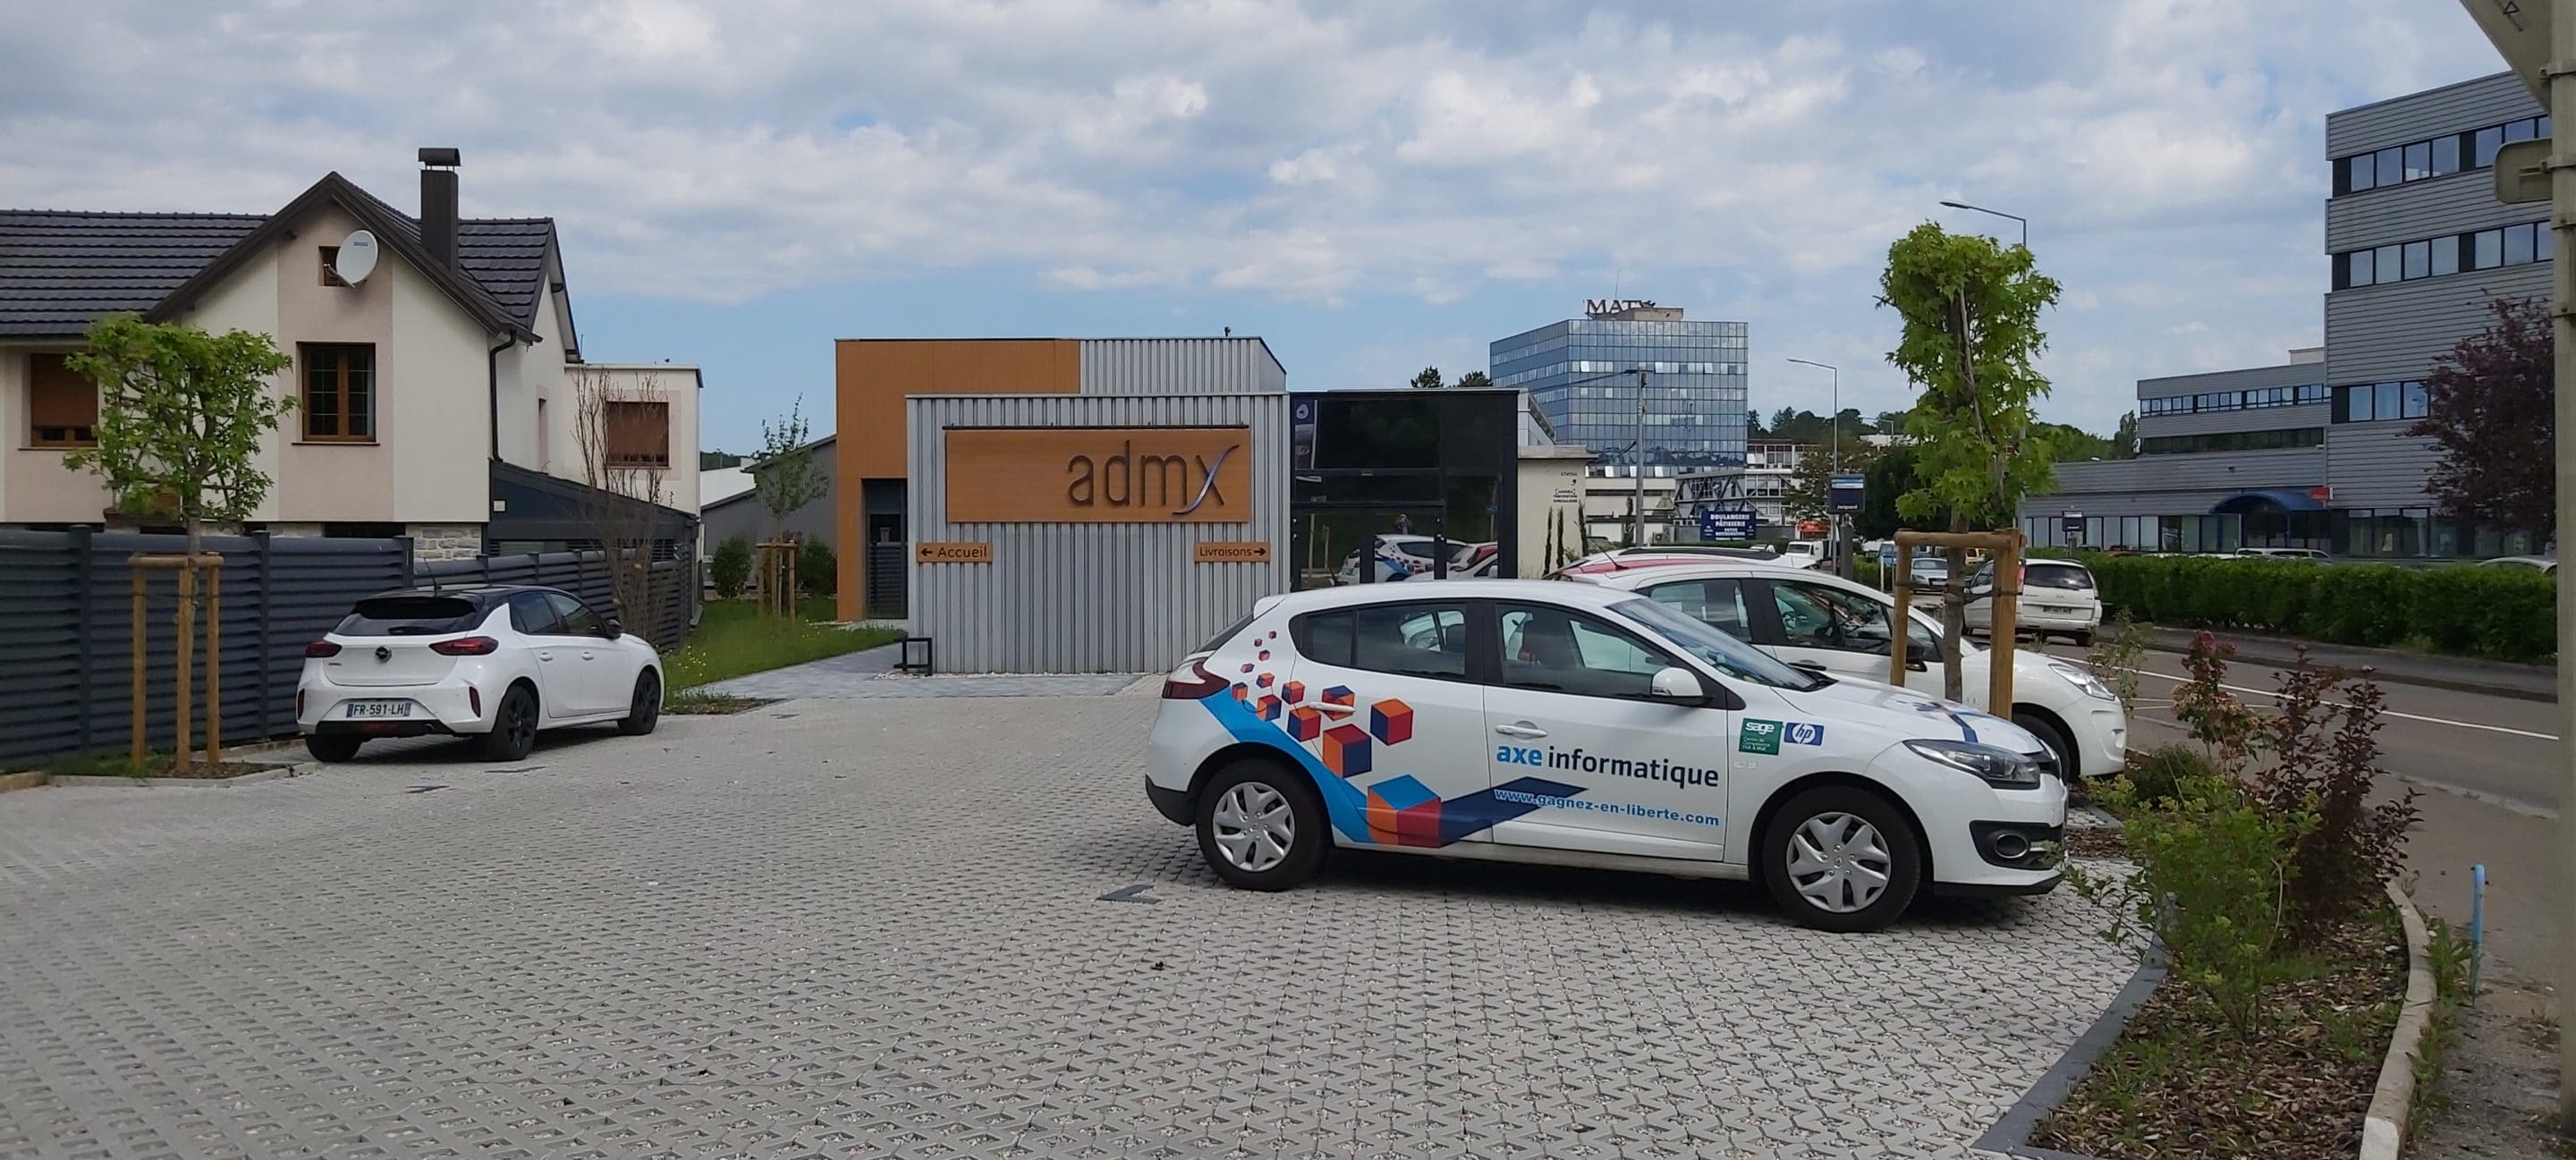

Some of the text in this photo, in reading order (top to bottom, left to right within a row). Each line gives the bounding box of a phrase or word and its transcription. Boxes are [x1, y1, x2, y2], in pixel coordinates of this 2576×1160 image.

[1066, 439, 1240, 515] admx
[937, 546, 987, 558] Accueil
[1199, 546, 1252, 556] Livraisons
[353, 704, 404, 715] FR-591-LH
[1745, 722, 1775, 735] sage
[1794, 722, 1814, 745] hp
[1496, 745, 1719, 789] axe informatique
[1494, 788, 1719, 826] www.gagnez-en-liberte.com
